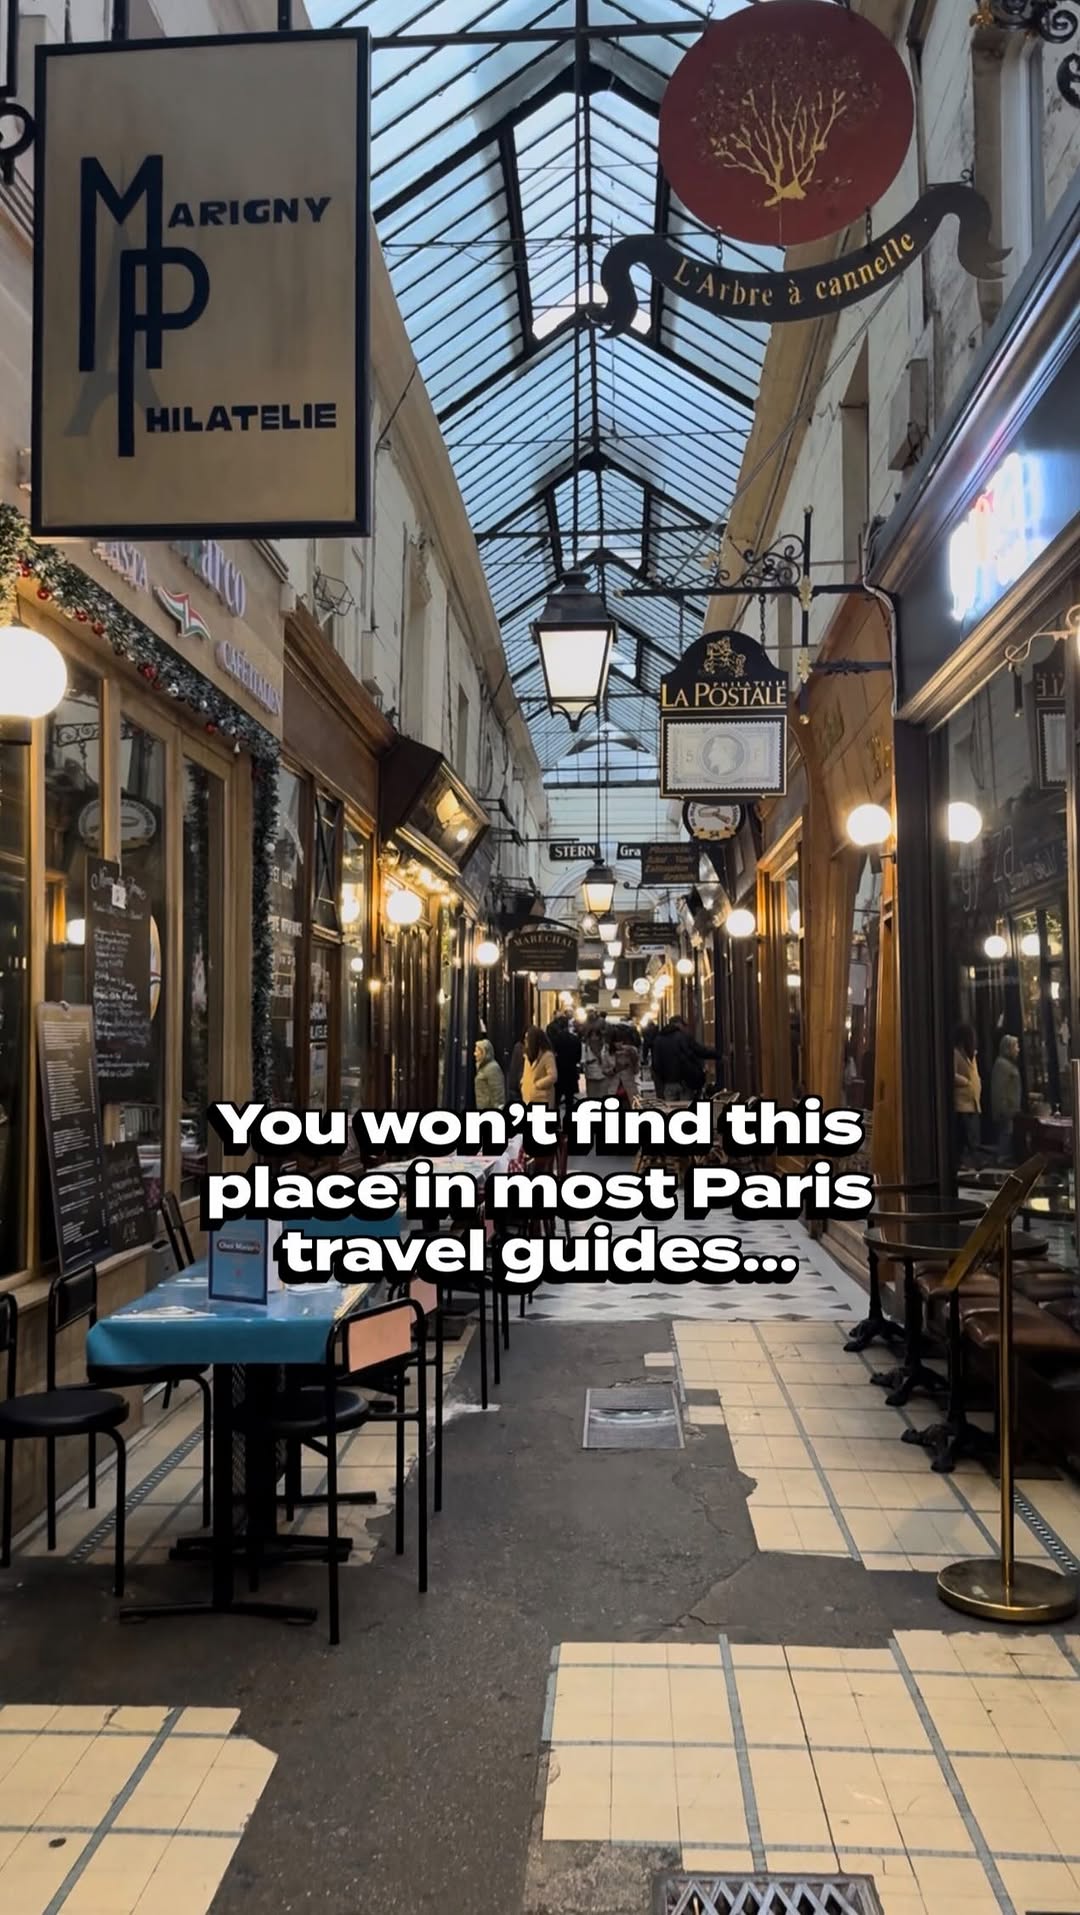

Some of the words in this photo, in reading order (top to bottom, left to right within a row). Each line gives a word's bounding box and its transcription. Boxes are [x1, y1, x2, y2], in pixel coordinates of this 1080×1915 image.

[673, 258, 774, 306] L'Arbre
[788, 279, 802, 305] à
[815, 232, 915, 299] cannelle
[661, 683, 689, 708] LA
[695, 681, 787, 707] POSTALE
[554, 845, 596, 858] STERN
[620, 845, 641, 857] Gra
